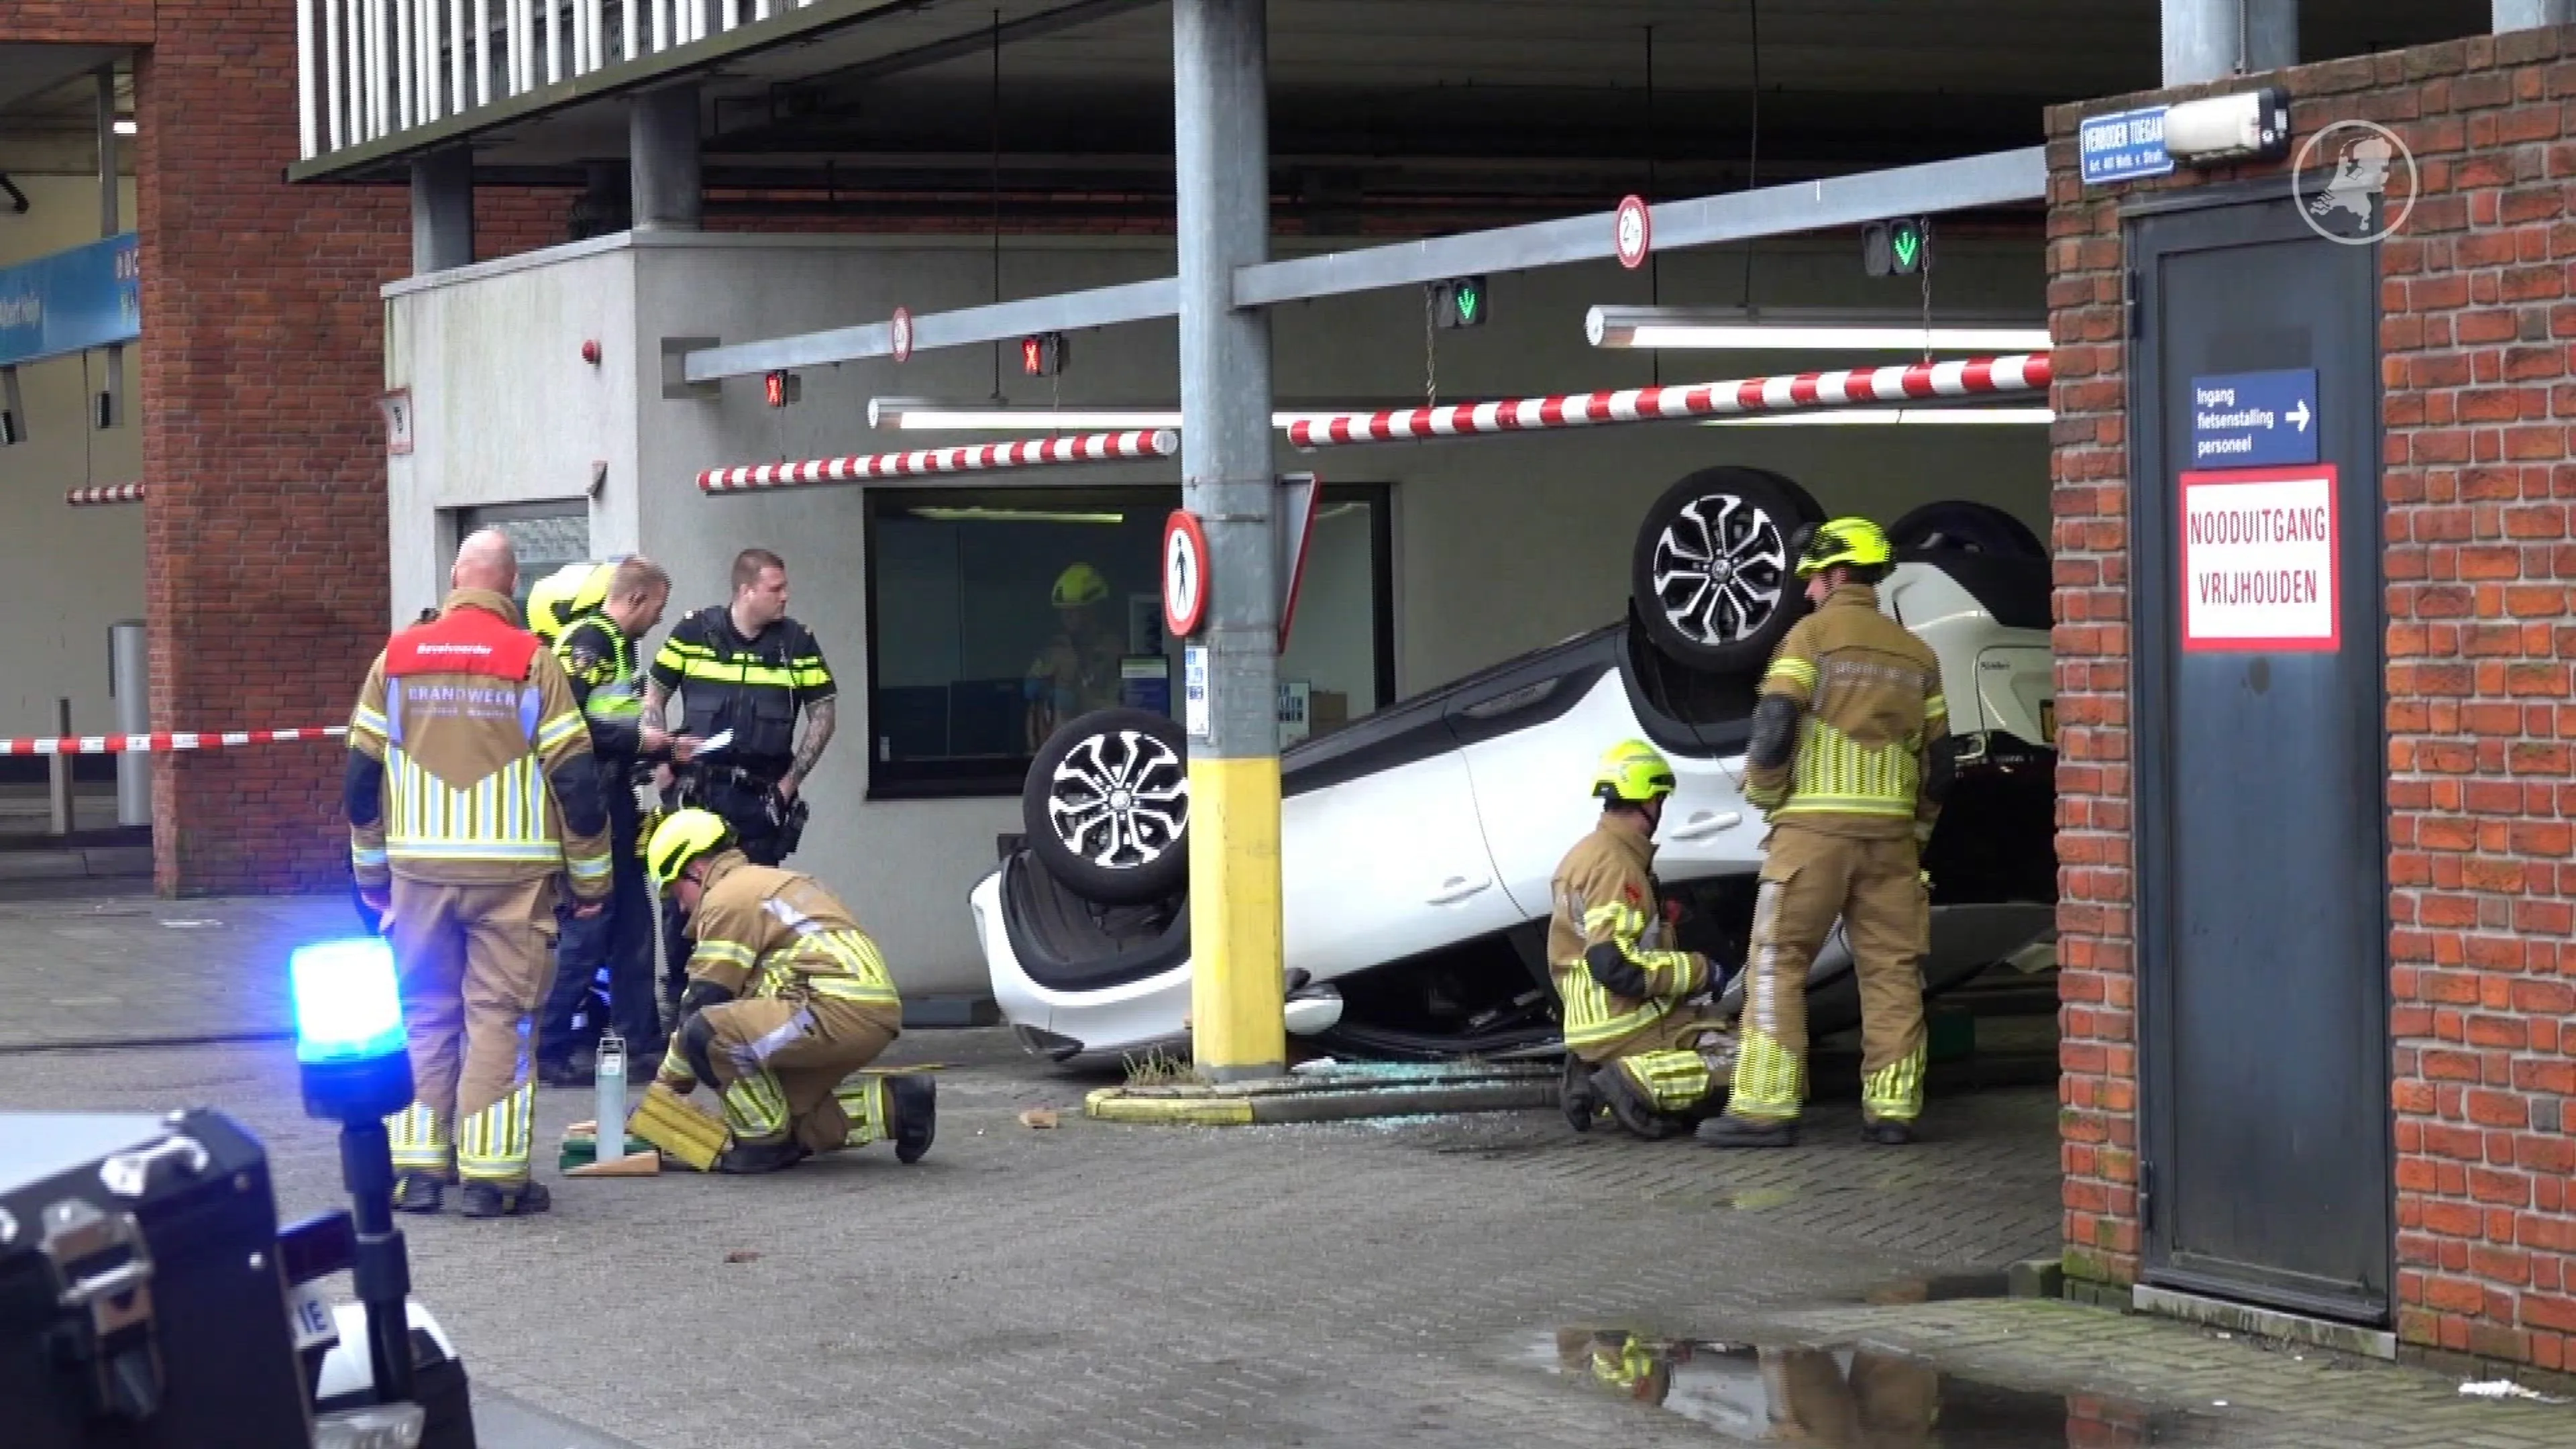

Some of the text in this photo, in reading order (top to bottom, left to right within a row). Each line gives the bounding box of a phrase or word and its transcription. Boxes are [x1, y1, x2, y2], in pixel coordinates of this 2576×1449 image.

[2084, 117, 2163, 153] VERBODEN TOEGAN
[2197, 388, 2235, 407] Ingang
[2197, 408, 2274, 430] fietsenstalling
[2197, 433, 2252, 459] personeel
[2190, 506, 2325, 545] NOODUITGANG
[2199, 570, 2317, 606] VRIJHOUDEN
[408, 686, 517, 706] BRANDWEER
